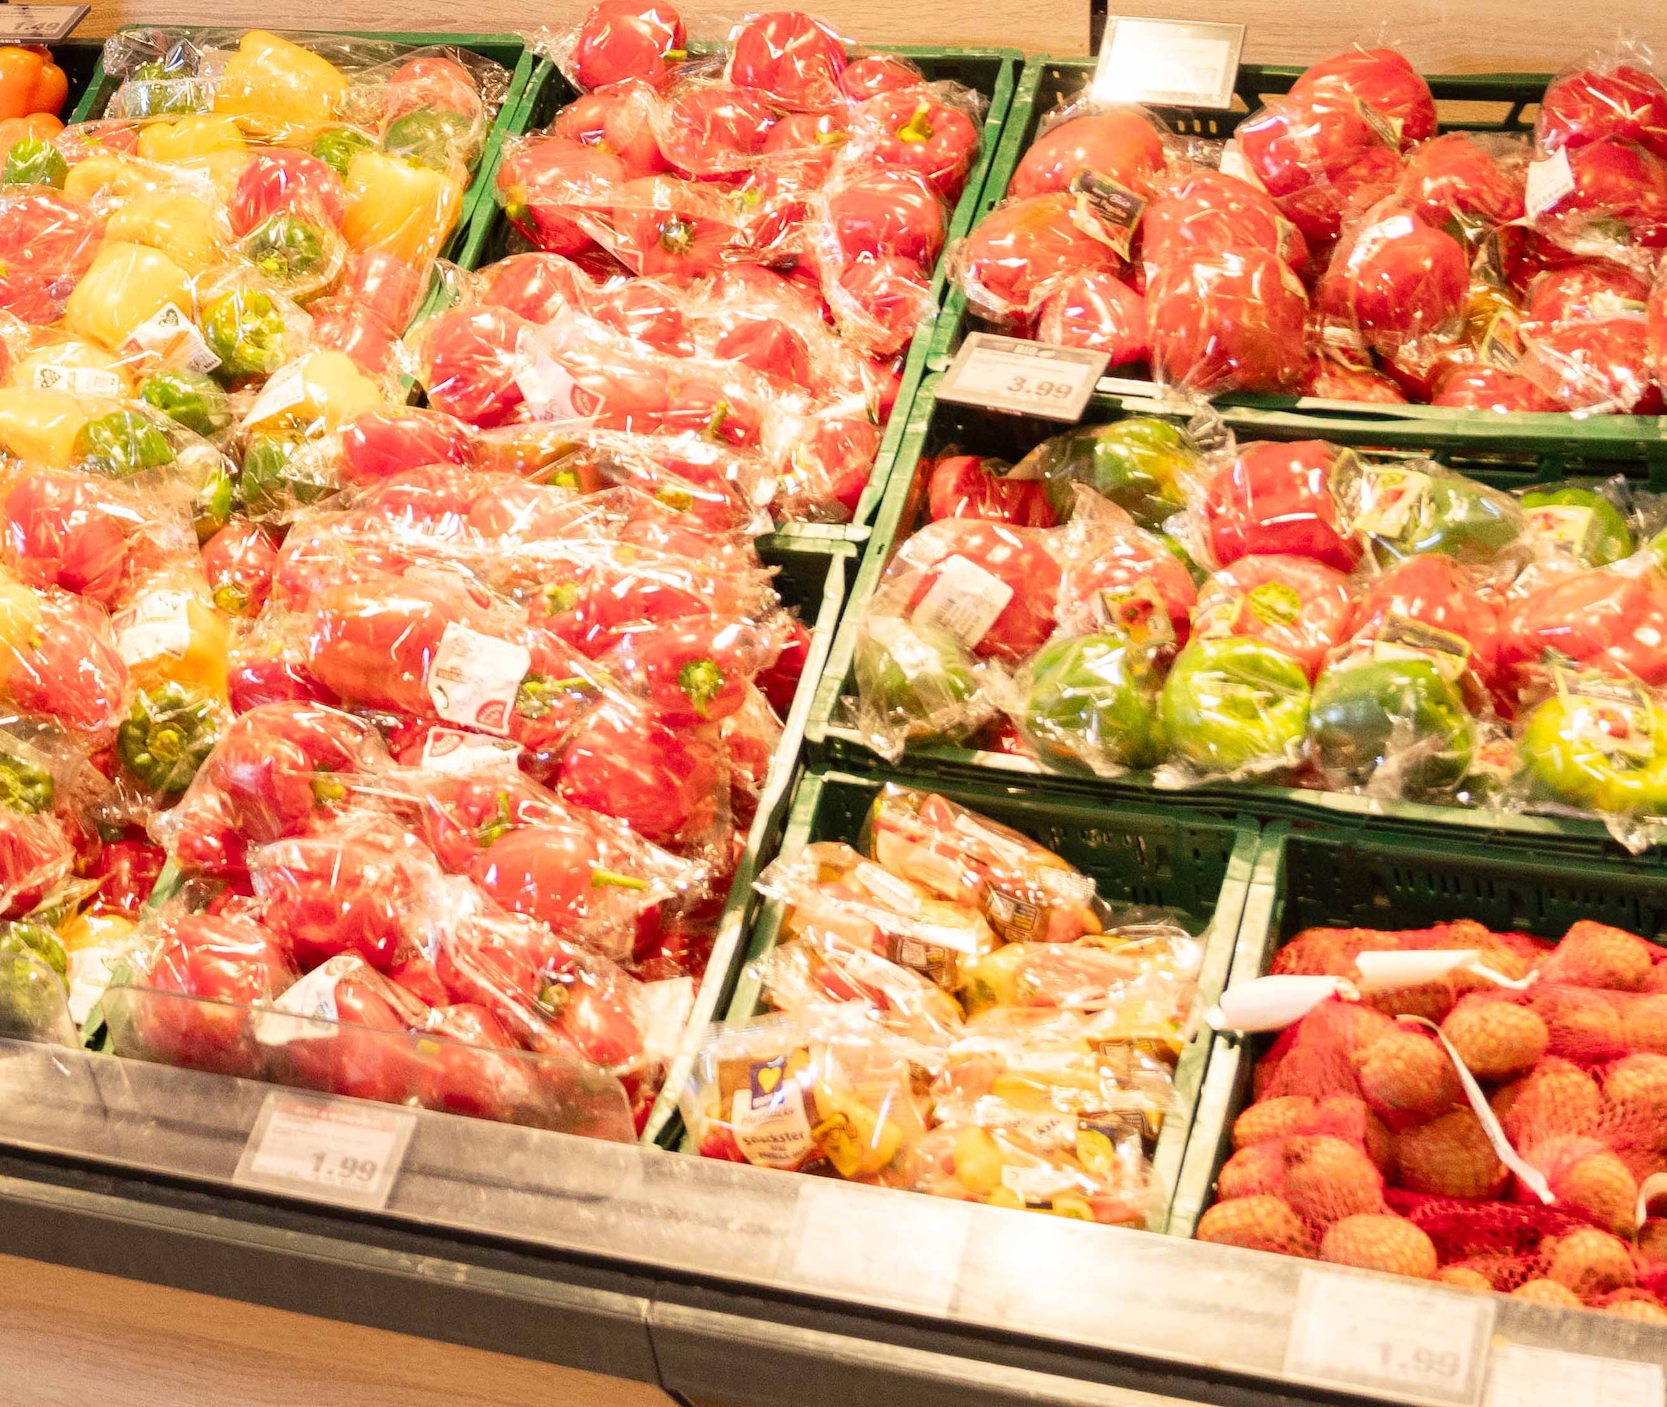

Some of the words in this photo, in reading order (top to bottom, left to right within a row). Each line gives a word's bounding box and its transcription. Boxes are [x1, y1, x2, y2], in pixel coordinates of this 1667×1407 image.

[14, 21, 61, 31] 1.49
[1007, 376, 1073, 400] 3.99
[312, 1151, 379, 1182] 1.99
[1375, 1342, 1461, 1378] 1.99
